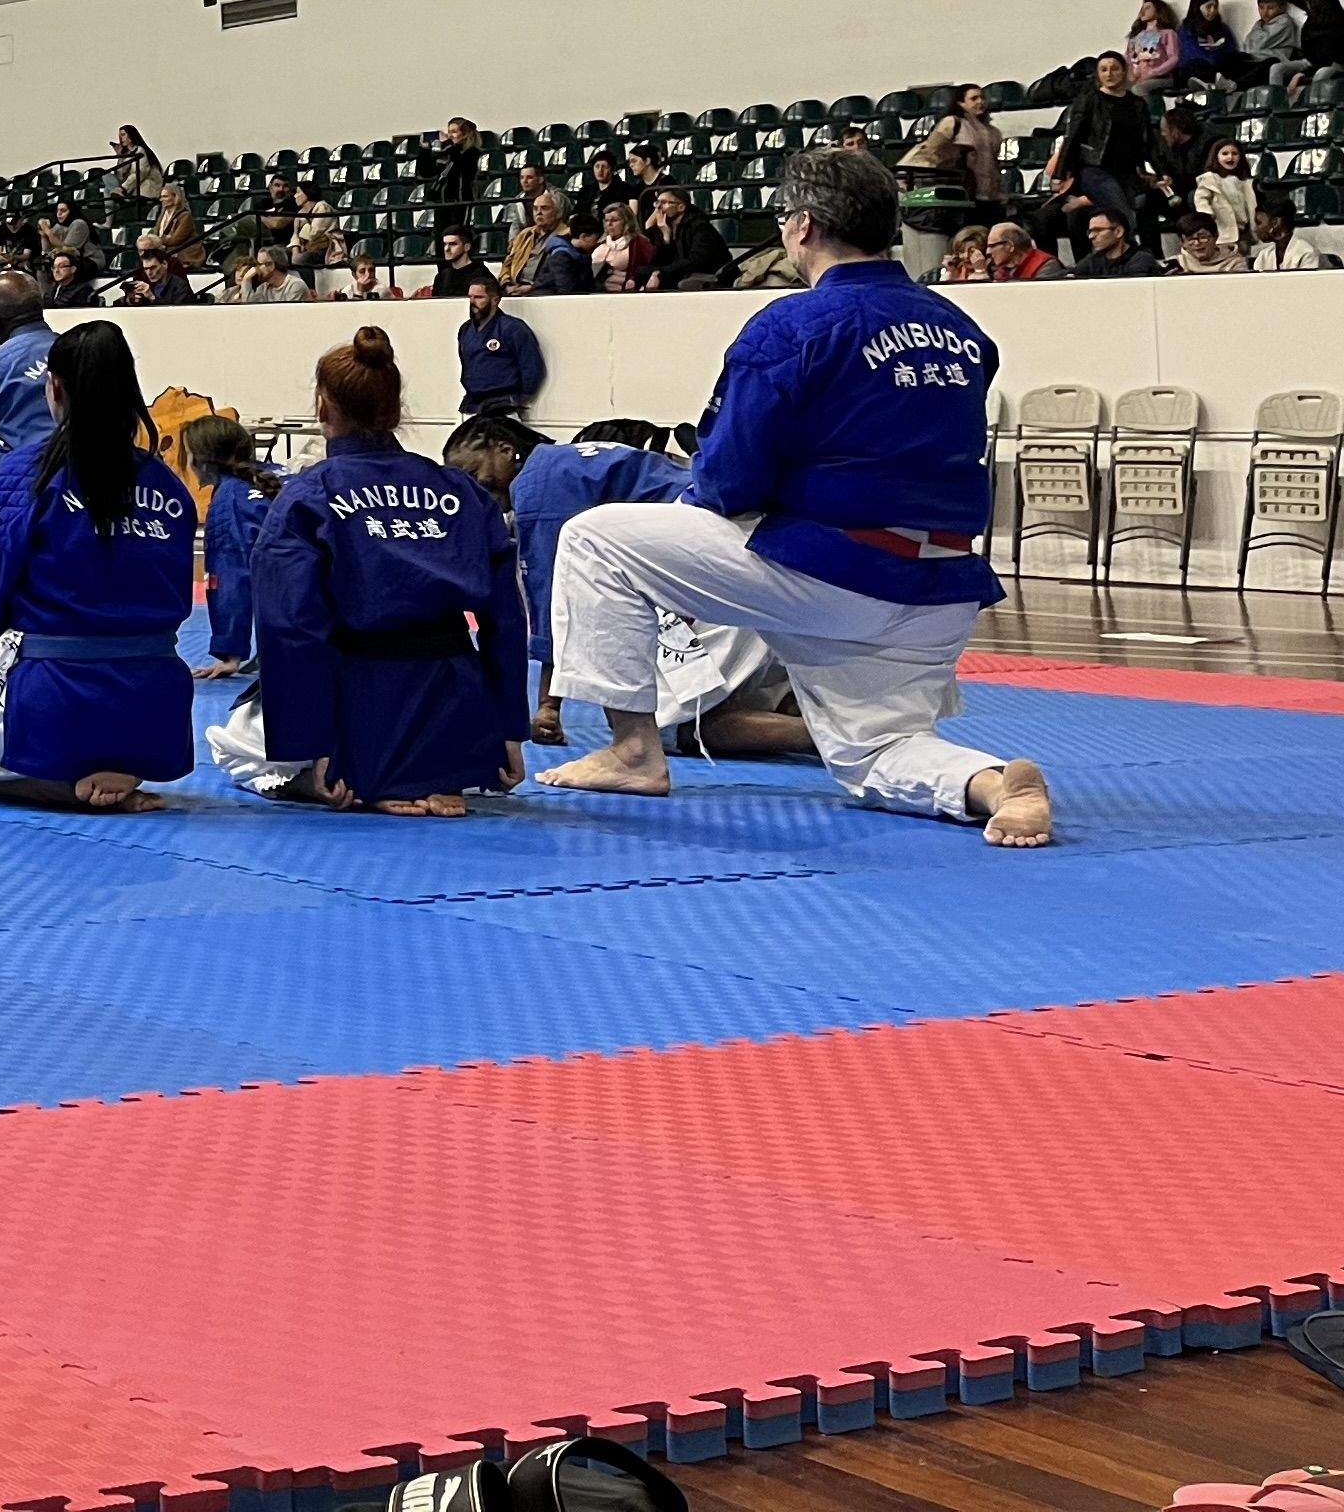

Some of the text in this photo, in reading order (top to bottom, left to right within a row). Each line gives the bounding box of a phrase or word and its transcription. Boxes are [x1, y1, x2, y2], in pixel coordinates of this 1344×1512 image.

[862, 323, 981, 370] NANBUDO
[893, 361, 970, 388] 南武道
[62, 485, 184, 519] NUDO
[328, 485, 461, 520] NANBUDO
[365, 515, 448, 540] 南武道
